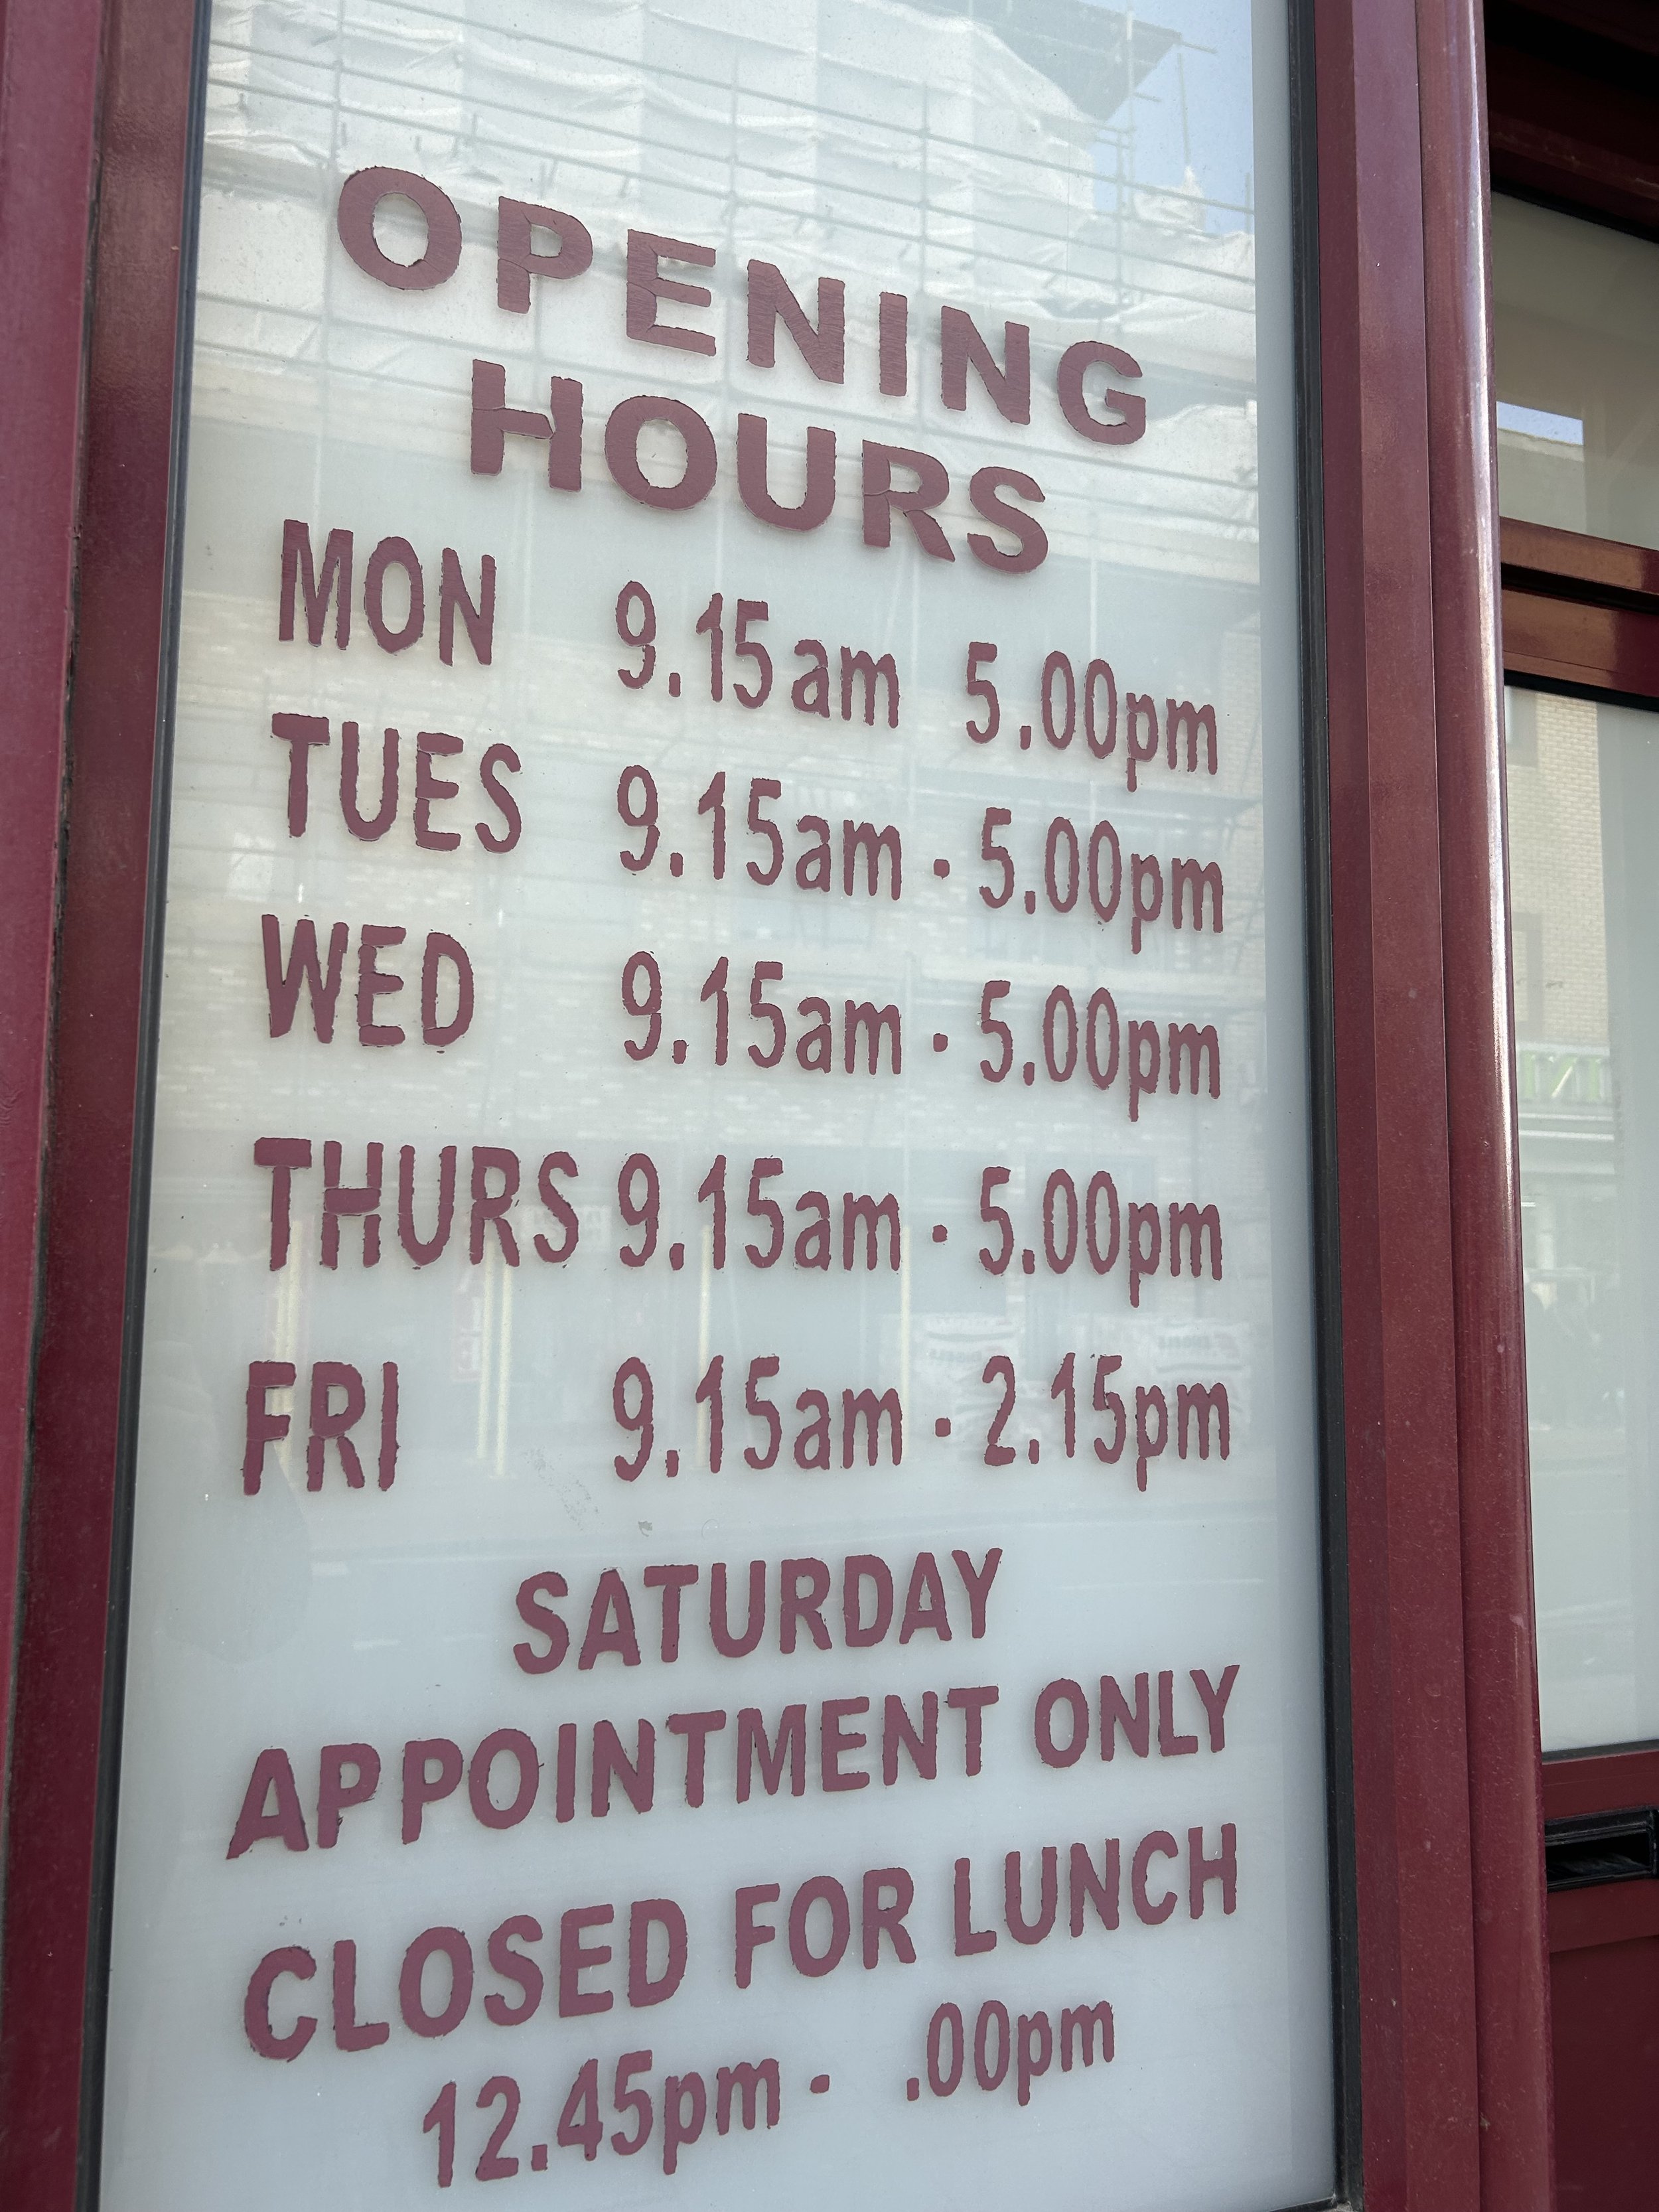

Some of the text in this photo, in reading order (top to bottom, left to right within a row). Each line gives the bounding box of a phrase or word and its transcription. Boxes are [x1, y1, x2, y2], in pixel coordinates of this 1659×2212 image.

[337, 166, 1147, 445] OPENING
[470, 359, 1048, 573] HOURS
[280, 520, 496, 664] MON
[617, 581, 899, 727] 9.15am
[273, 713, 521, 852] TUES
[618, 765, 901, 899] 9.15am
[981, 807, 1222, 953] 5.00pm
[262, 914, 474, 1051] WED
[622, 951, 901, 1074] 9.15am
[981, 981, 1220, 1120] 5.00pm
[254, 1137, 579, 1268] THURS
[617, 1153, 901, 1271] 9.15am
[980, 1166, 1222, 1307] 5.00pm
[244, 1361, 399, 1497] FRI
[613, 1355, 902, 1483] 9.15am
[983, 1355, 1230, 1491] 2.15pm
[514, 1548, 1002, 1675] SATURDAY
[228, 1664, 1239, 1860] APPOINTMENT ONLY
[245, 1823, 1237, 2060] CLOSED FOR LUNCH
[423, 2049, 780, 2187] 12.45pm
